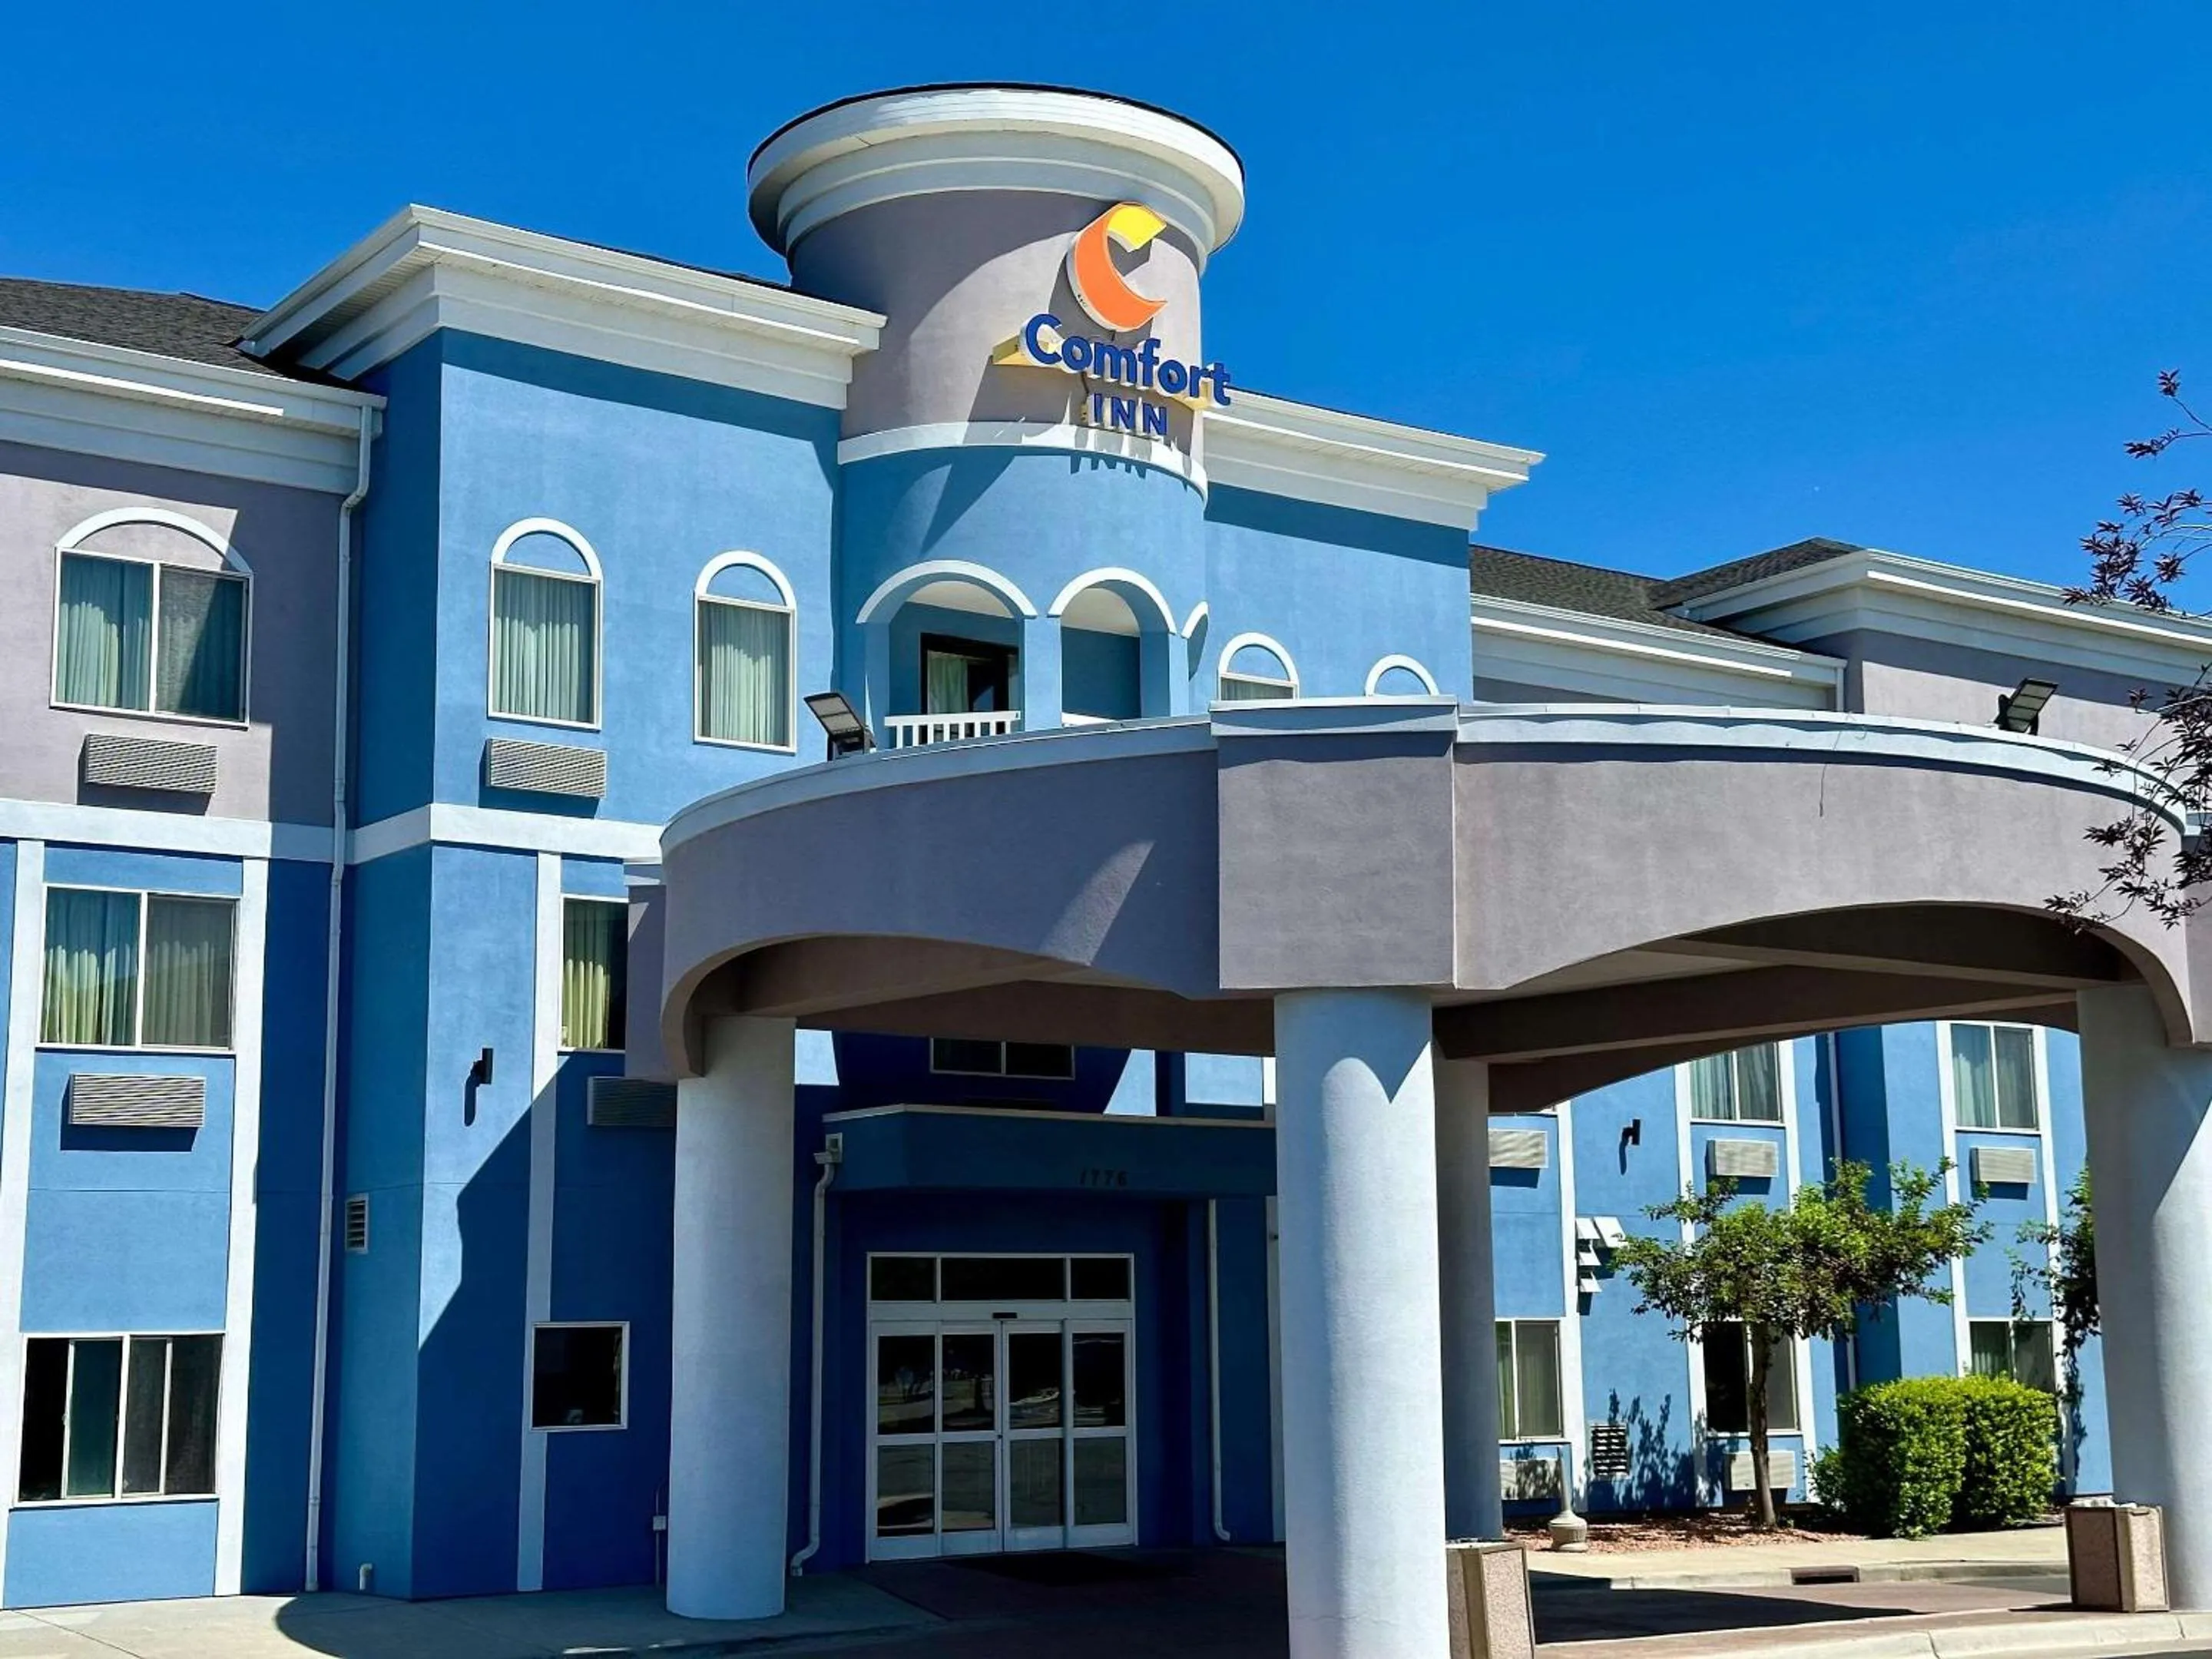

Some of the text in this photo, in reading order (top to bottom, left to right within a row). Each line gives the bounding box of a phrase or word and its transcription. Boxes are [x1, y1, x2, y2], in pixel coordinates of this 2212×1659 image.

[1025, 313, 1231, 407] Comfort
[1093, 392, 1168, 436] INN
[1079, 1168, 1128, 1187] 1776
